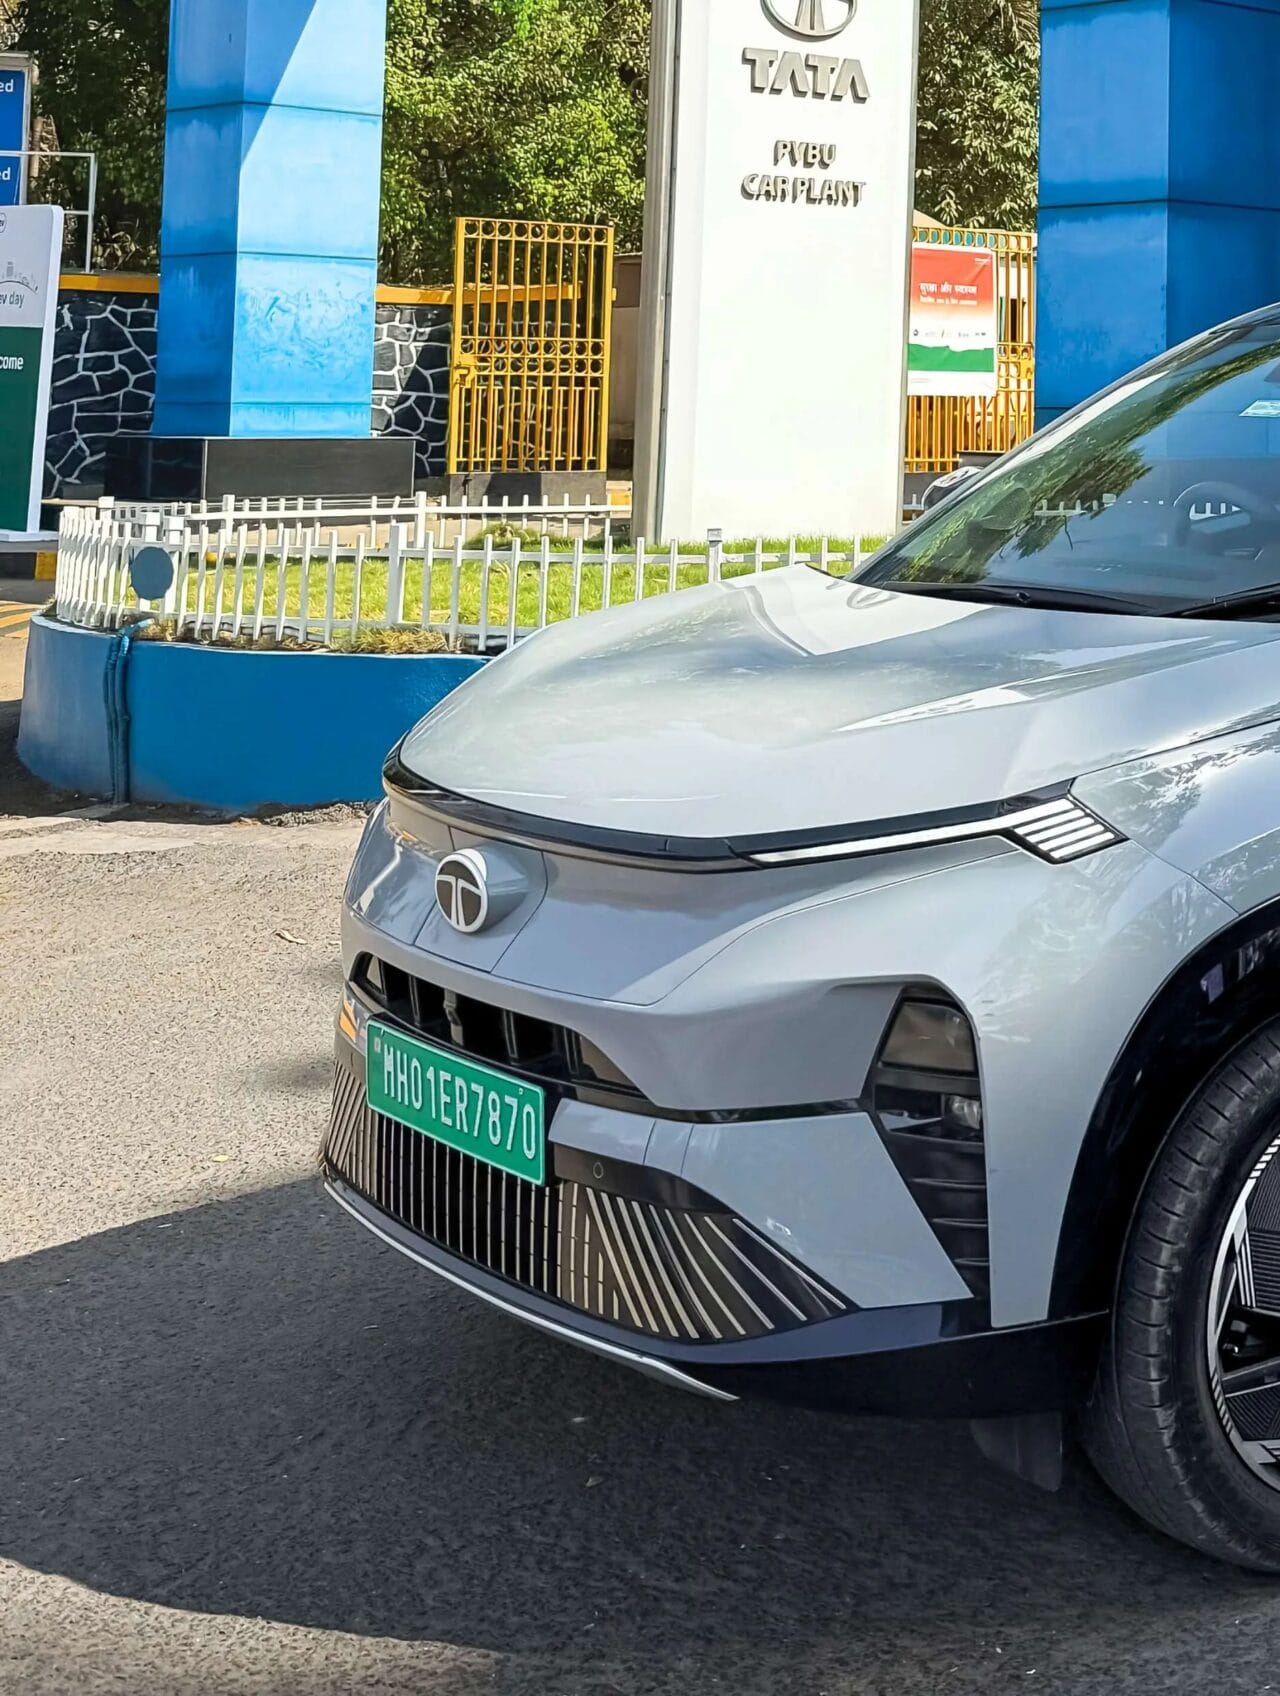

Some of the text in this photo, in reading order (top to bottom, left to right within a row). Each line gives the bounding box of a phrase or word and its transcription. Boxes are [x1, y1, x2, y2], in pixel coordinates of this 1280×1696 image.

[742, 47, 869, 103] TATA
[773, 140, 836, 169] PVBU
[0, 167, 11, 180] d
[741, 173, 867, 208] CAR PLANT
[9, 291, 25, 308] day
[383, 1043, 536, 1160] MH01ER7870
